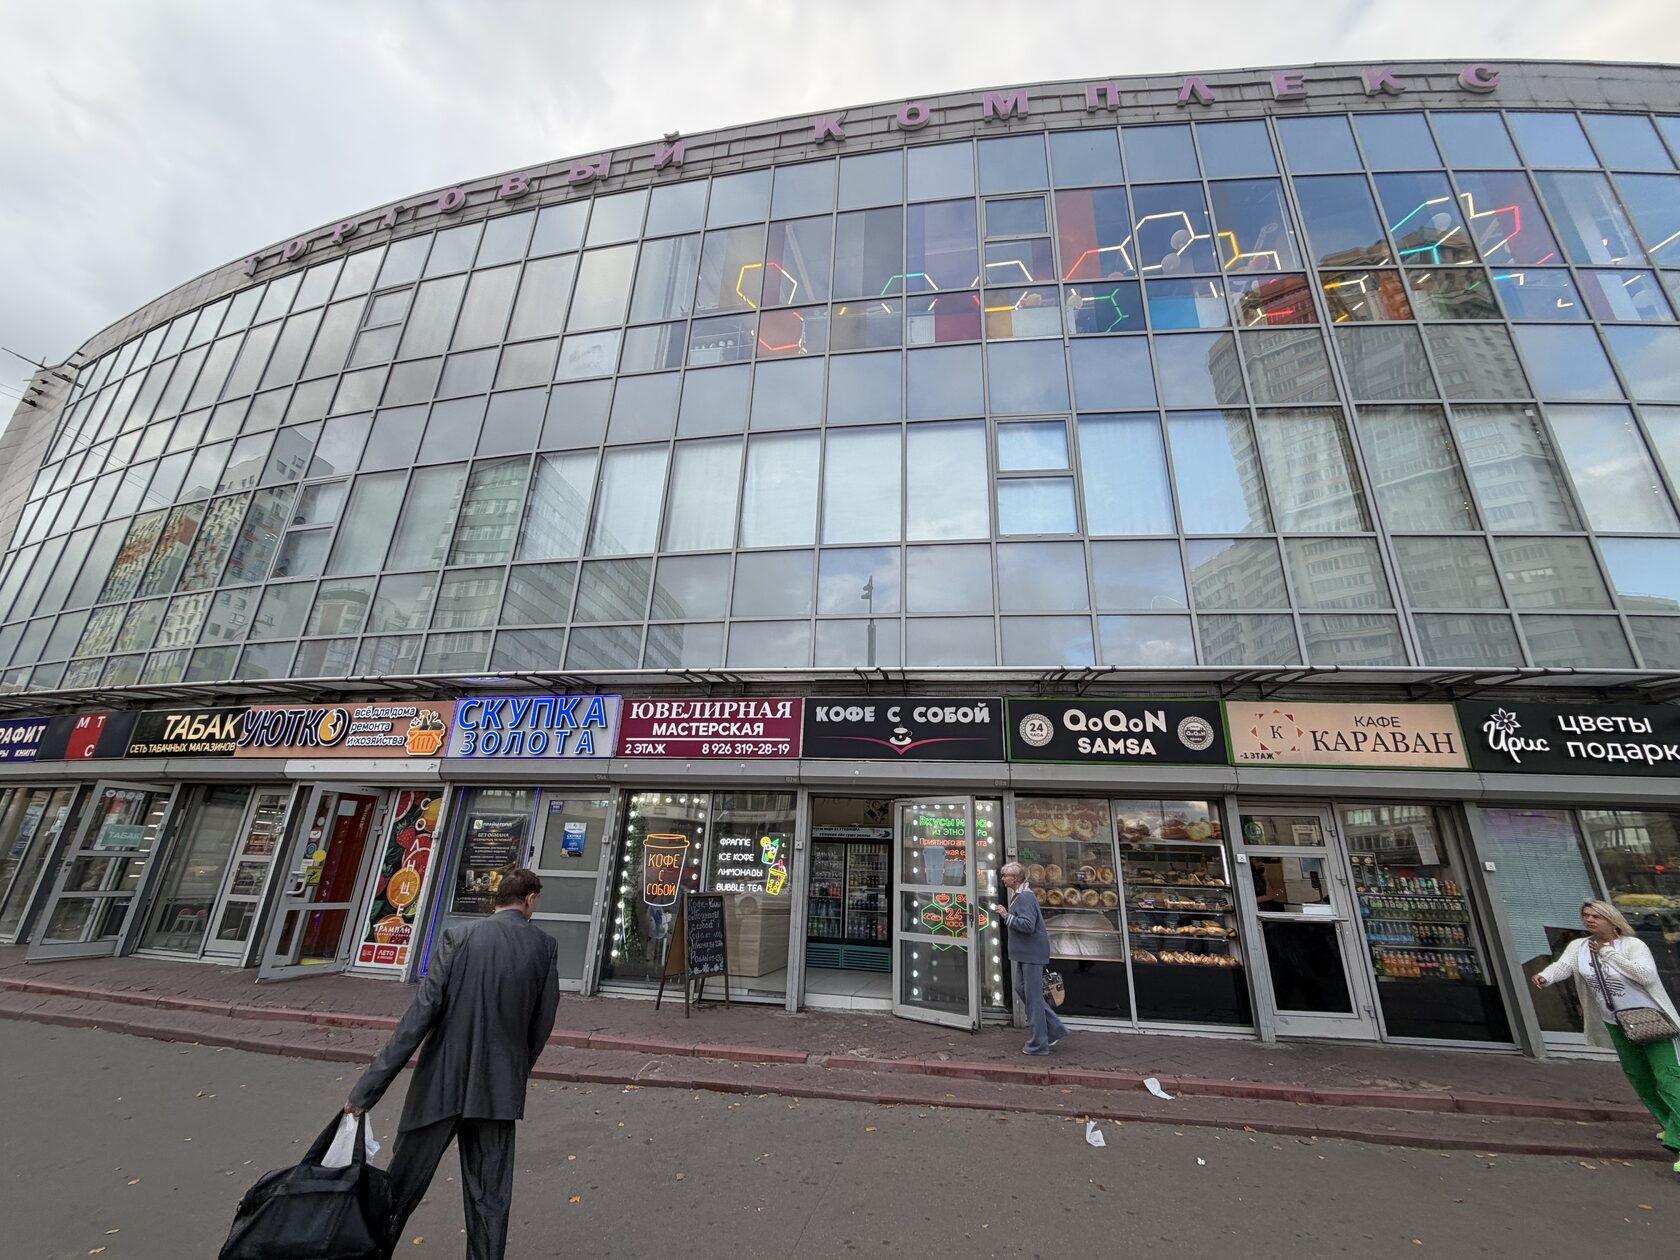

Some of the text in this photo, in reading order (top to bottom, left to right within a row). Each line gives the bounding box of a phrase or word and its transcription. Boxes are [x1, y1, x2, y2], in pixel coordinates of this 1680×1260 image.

[243, 64, 1499, 278] ТОРГОВЫЙ КОМПЛЕКС
[355, 706, 416, 719] всё для дома
[457, 696, 606, 730] СКУПКА
[630, 701, 793, 719] ЮВЕЛИРНАЯ
[816, 702, 990, 723] КОФЕ С СОБОЙ
[163, 713, 245, 741] ТАБАК
[350, 722, 391, 733] ремонта
[1029, 723, 1043, 733] 24
[1354, 716, 1401, 728] КАФЕ
[1558, 715, 1653, 735] цветы
[652, 722, 765, 736] МАСТЕРСКАЯ
[1270, 725, 1284, 740] К
[355, 735, 405, 746] хозяйства
[458, 729, 594, 756] ЗОЛОТА
[1077, 737, 1157, 755] SAMSA
[1309, 730, 1458, 754] КАРАВАН
[1483, 720, 1550, 764] Ирис
[14, 748, 37, 757] КНИГИ
[129, 742, 236, 753] СЕТЬ ТАБАЧНЫХ МАГАЗИНОВ
[625, 744, 666, 754] 2 ЭТАЖ
[702, 743, 790, 755] 8 926 319-28-19
[1566, 741, 1680, 766] подарк
[1250, 752, 1275, 760] ЭТАЖ
[108, 831, 140, 839] ТАБАК
[719, 838, 751, 847] ФРАППЕ
[396, 797, 431, 917] СОЛНЦЕ
[648, 853, 680, 868] КОФЕ
[719, 853, 755, 862] ICE КОФЕ
[658, 869, 664, 882] С
[717, 868, 763, 877] ЛИМОНАДЫ
[646, 882, 675, 896] СОБОЙ
[716, 883, 763, 893] BUBBLE TEA
